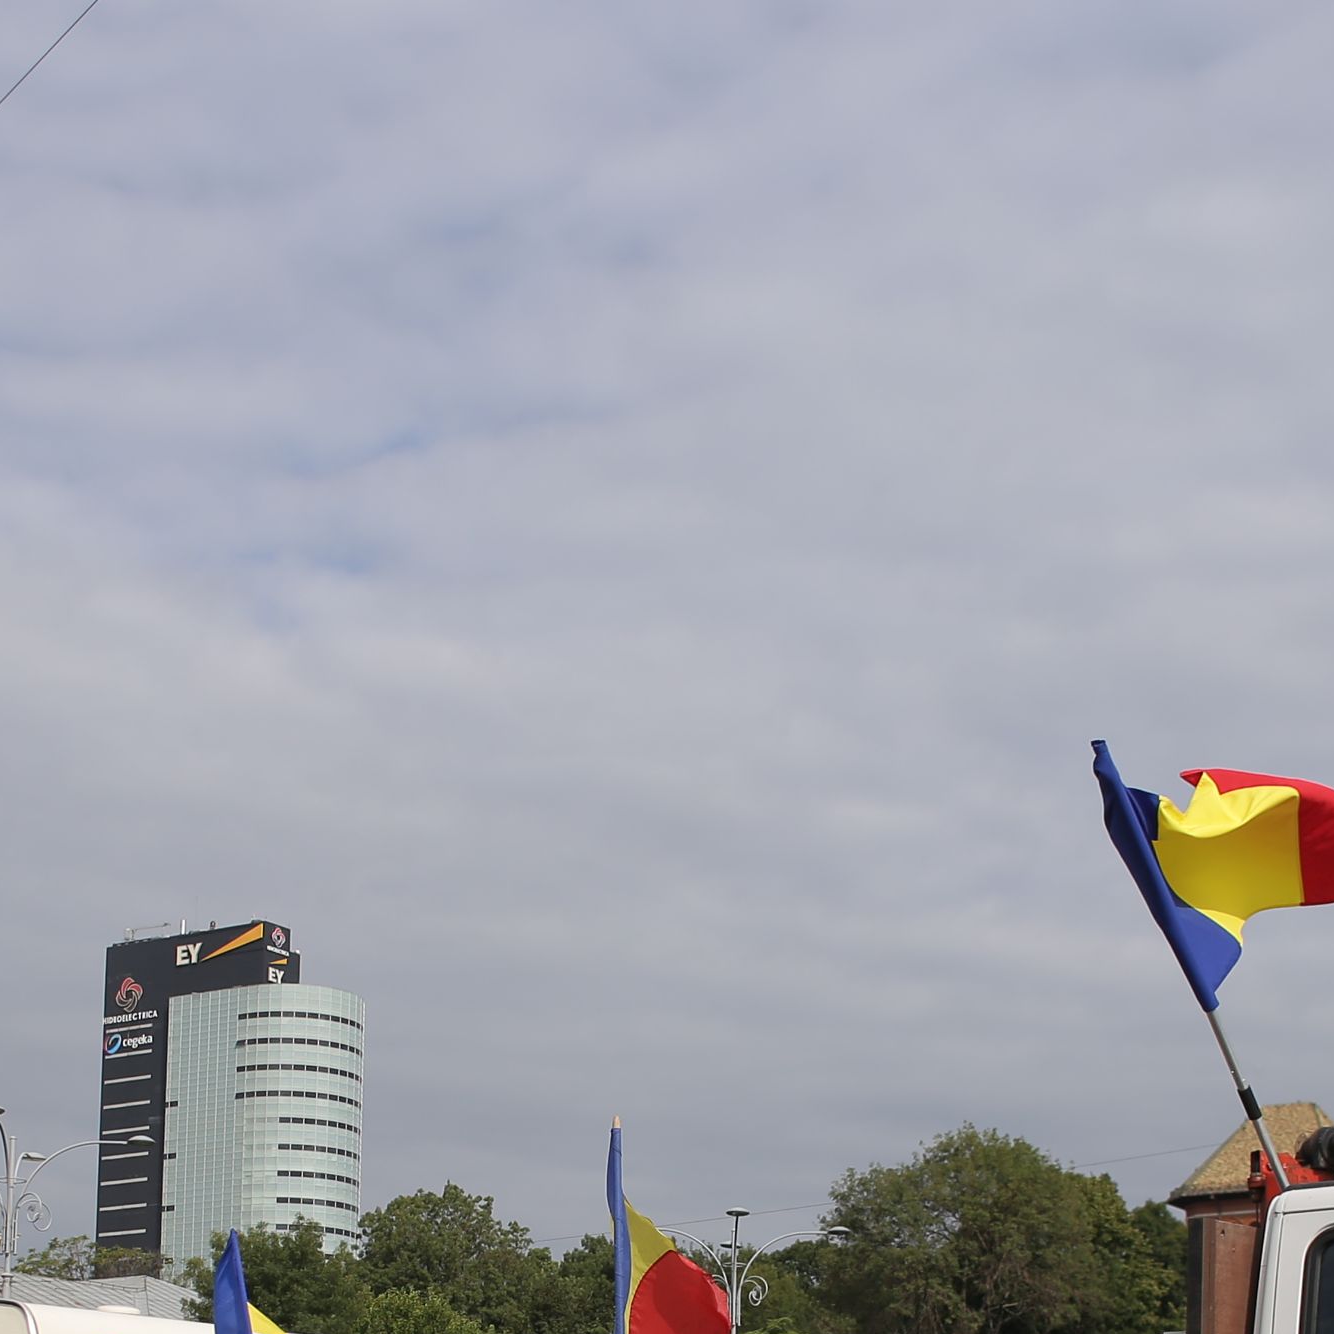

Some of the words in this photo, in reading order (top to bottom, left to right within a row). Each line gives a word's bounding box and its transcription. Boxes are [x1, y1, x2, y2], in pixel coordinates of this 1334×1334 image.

[176, 942, 203, 966] EY
[268, 966, 285, 984] EY
[103, 1010, 158, 1025] HIDROELECTRICA
[122, 1034, 153, 1049] cegeka
